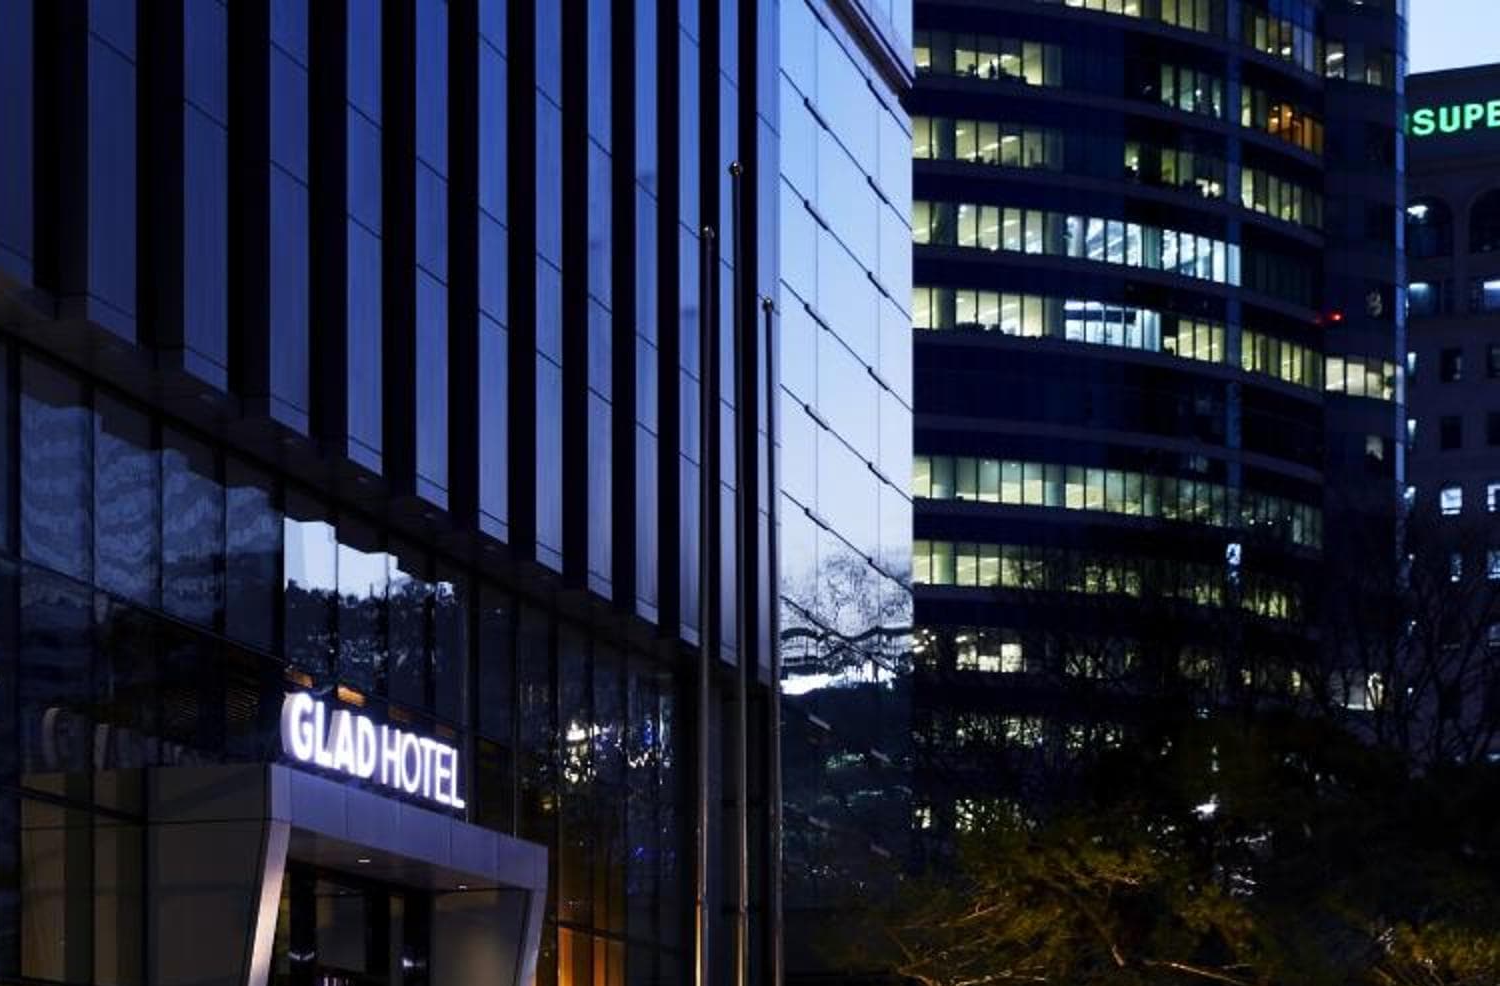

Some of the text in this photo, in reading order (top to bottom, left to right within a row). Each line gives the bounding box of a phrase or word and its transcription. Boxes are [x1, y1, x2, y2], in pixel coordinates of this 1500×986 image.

[1405, 100, 1500, 137] SUPE
[282, 692, 376, 778] GLAD
[381, 724, 465, 809] HOTEL
